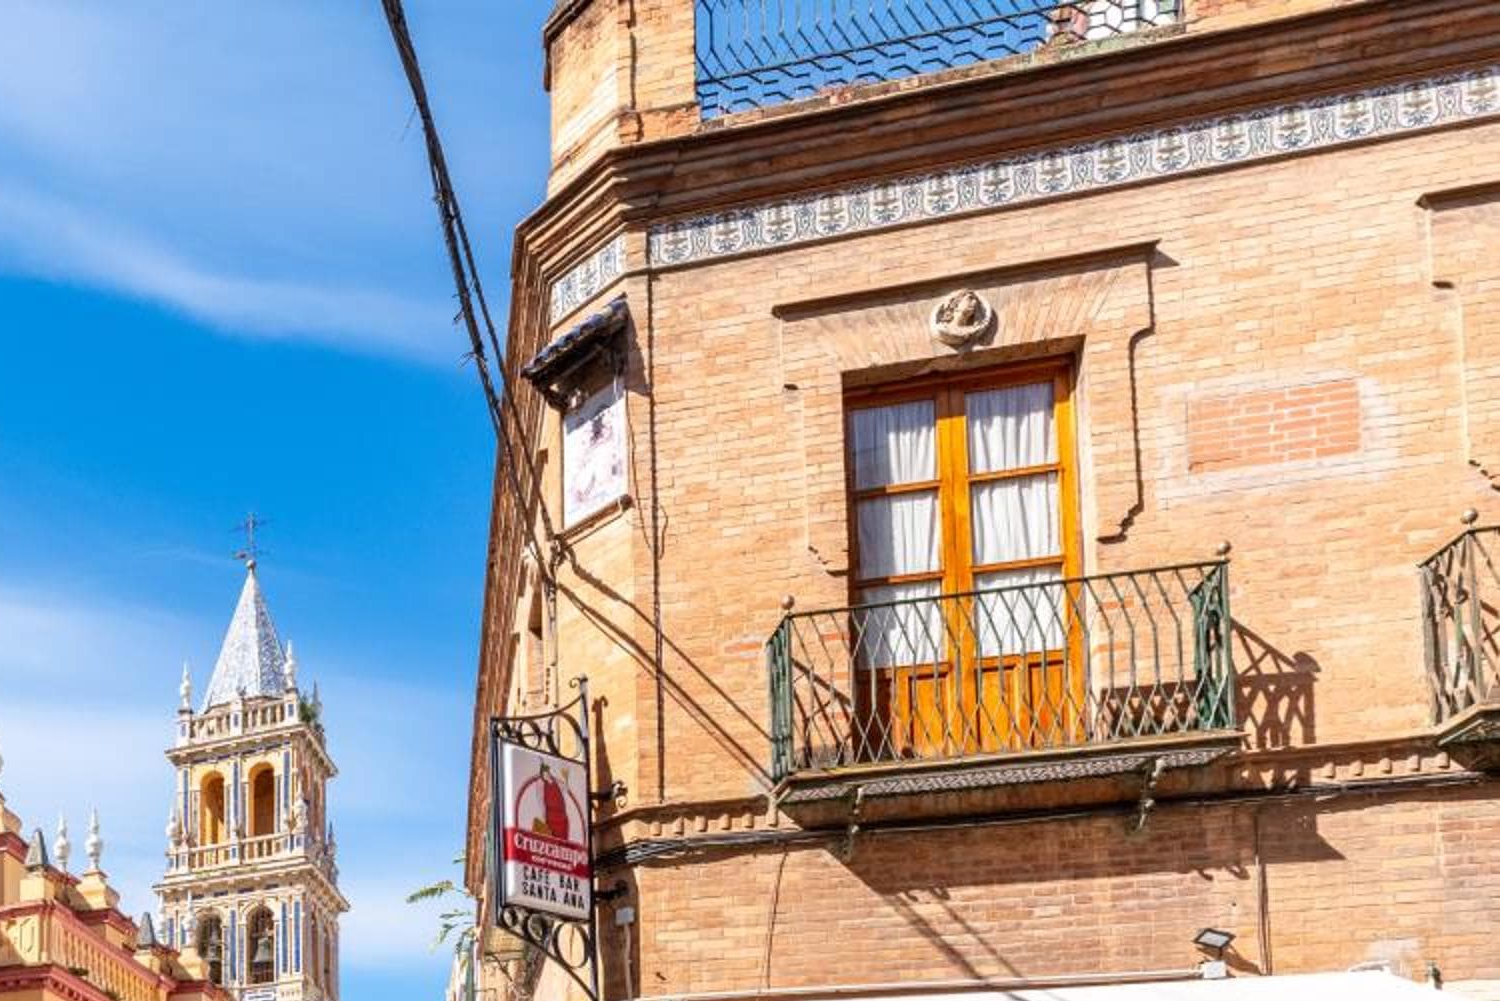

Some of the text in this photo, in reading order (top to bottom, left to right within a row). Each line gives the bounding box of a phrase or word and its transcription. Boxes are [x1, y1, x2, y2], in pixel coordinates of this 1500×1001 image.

[560, 873, 579, 892] BAR
[522, 881, 585, 910] SANTA ANA
